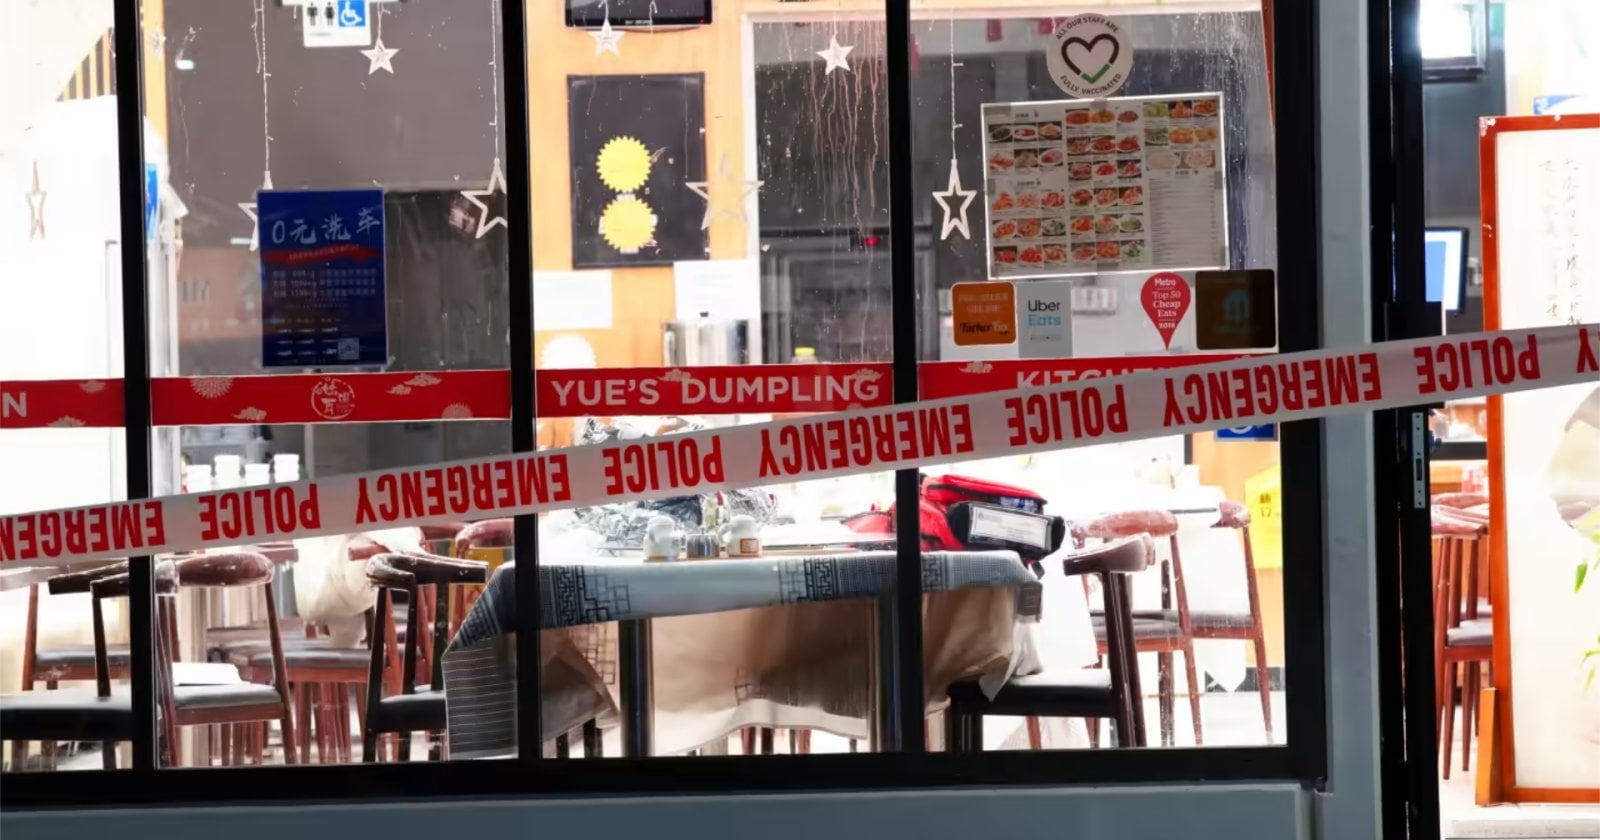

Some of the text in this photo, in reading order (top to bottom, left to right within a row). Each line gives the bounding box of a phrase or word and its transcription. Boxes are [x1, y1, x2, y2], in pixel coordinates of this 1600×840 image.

[1056, 16, 1118, 40] ALL OUR STAFF ARE
[1060, 73, 1121, 95] FULLY VACCINATED
[1154, 278, 1176, 287] Metro
[1152, 290, 1181, 300] Top 50
[1027, 299, 1061, 312] Uber
[1152, 300, 1181, 309] Cheap
[1027, 314, 1062, 326] Eats
[552, 378, 660, 407] YUE'S
[680, 374, 878, 406] DUMPLING
[3, 392, 27, 417] N
[0, 329, 1600, 561] Y POLICE EMERGENCY POLICE EMERGENCY POLICE EMERGENCY POLICE EMERGEN
